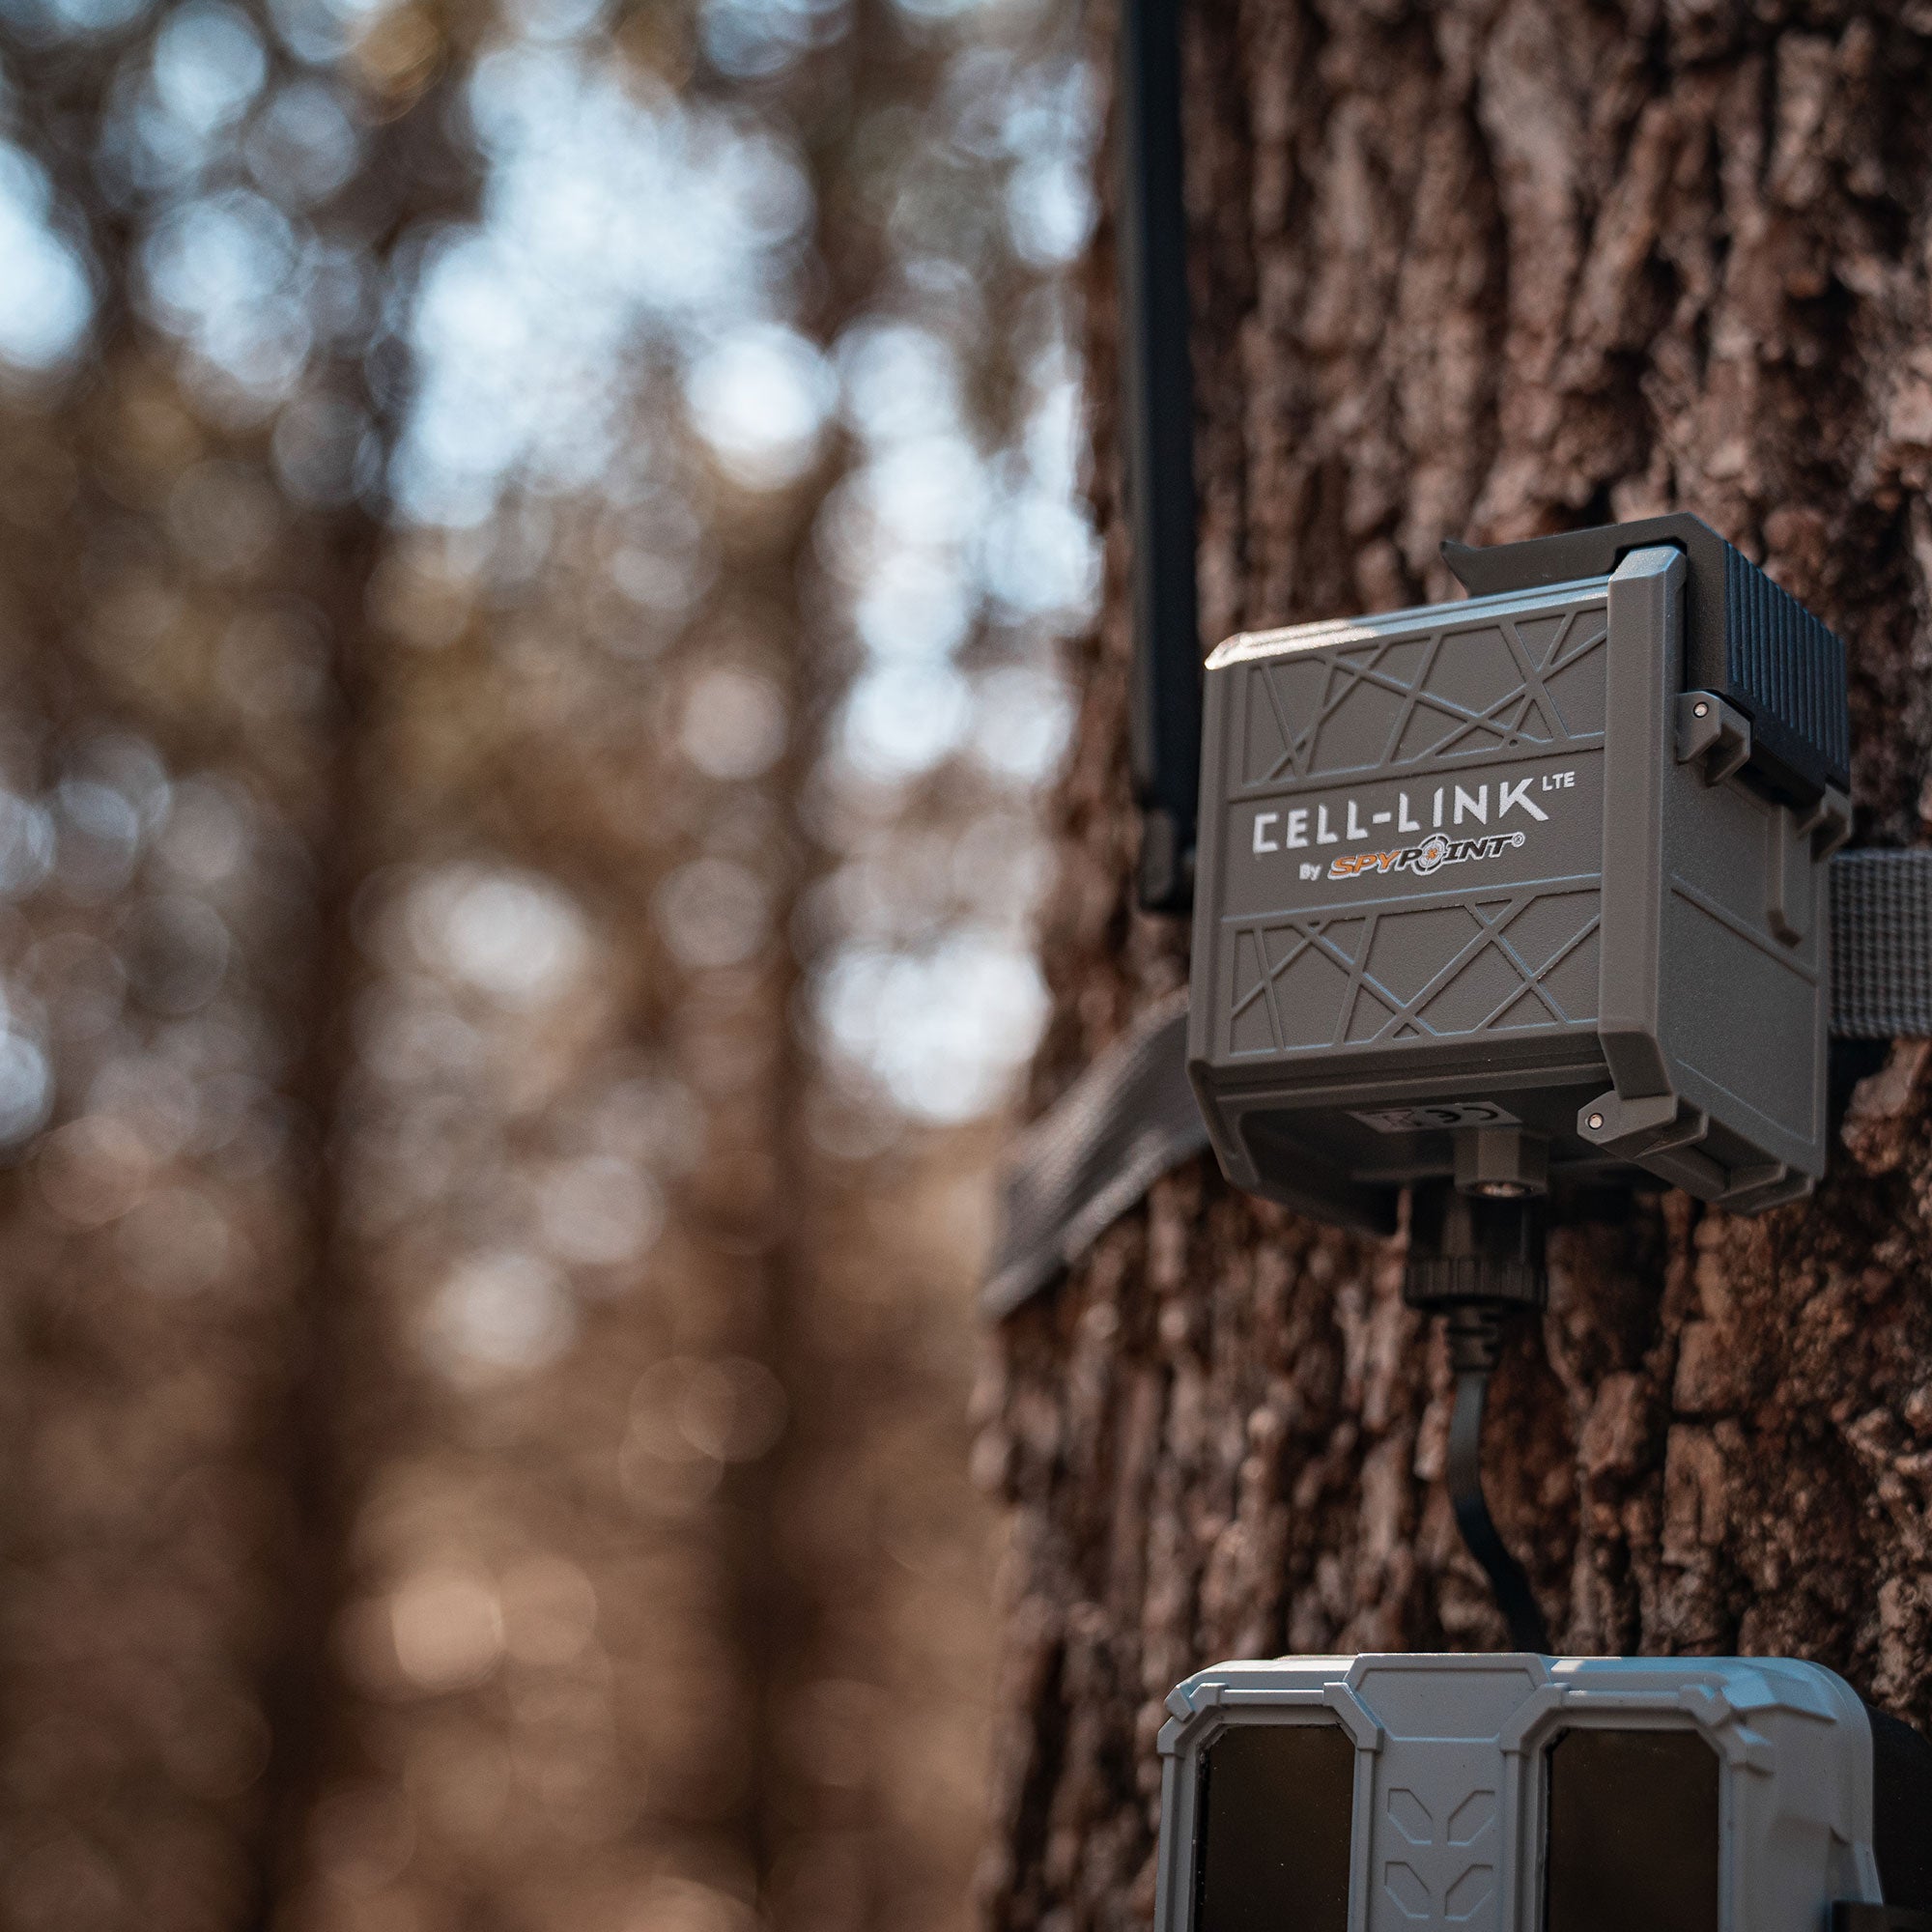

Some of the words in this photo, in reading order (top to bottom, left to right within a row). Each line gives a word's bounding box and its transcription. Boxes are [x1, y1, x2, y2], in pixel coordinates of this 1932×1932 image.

[1253, 778, 1548, 853] CELL-LINK
[1542, 771, 1576, 791] LTE
[1299, 863, 1322, 881] By
